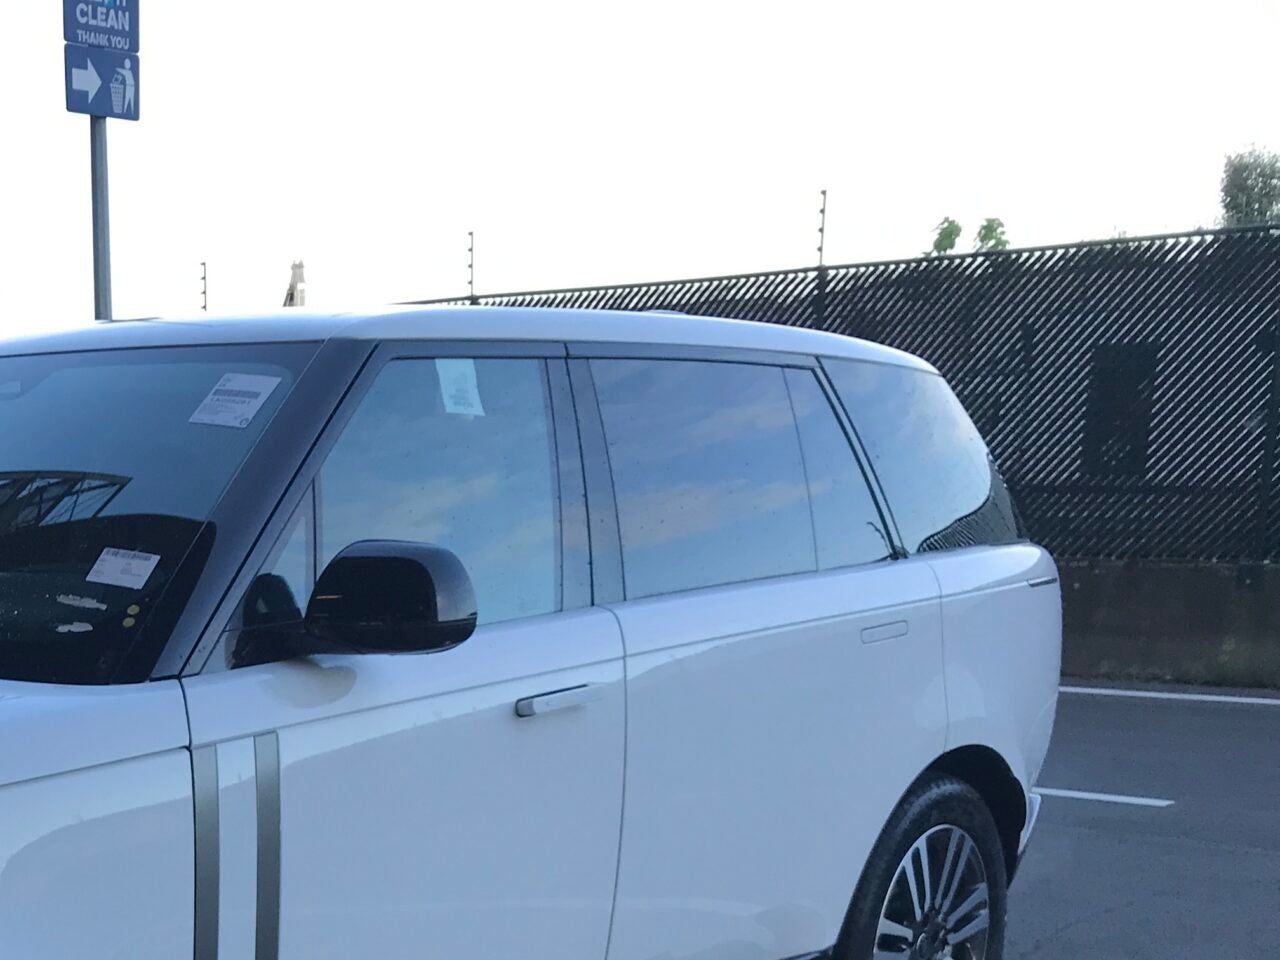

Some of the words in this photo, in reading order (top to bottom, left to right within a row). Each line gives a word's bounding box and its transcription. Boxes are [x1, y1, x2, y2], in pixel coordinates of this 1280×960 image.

[76, 2, 129, 31] CLEAN
[76, 30, 109, 46] THANK
[110, 35, 130, 50] YOU
